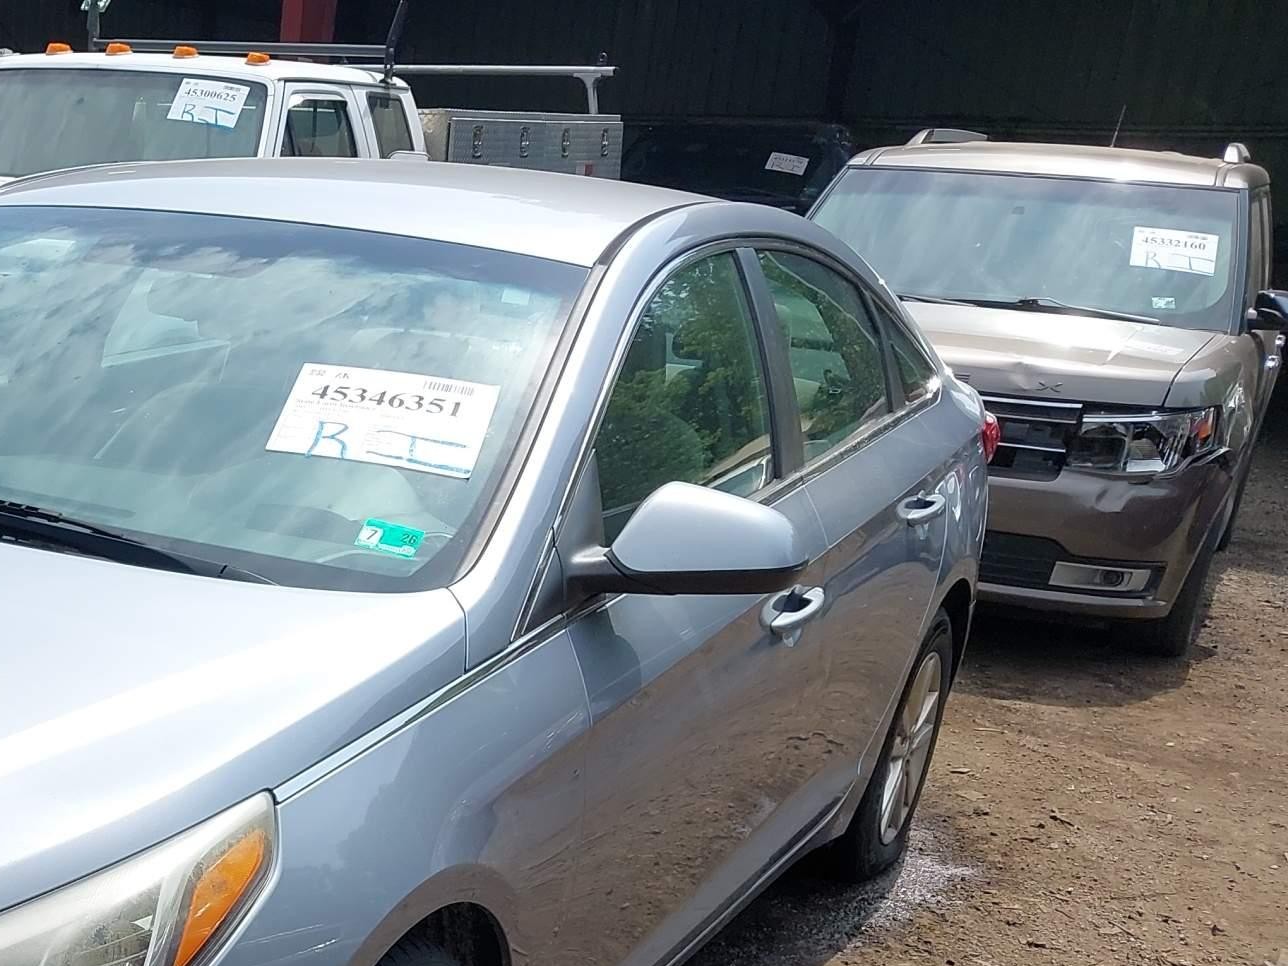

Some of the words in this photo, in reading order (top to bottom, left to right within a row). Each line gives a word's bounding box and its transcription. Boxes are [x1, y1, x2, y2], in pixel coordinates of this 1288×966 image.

[184, 87, 237, 102] 45300625
[1141, 236, 1206, 251] 45332160
[311, 384, 463, 417] 45346351
[304, 420, 350, 459] R
[365, 529, 379, 541] 7
[401, 533, 418, 545] 26
